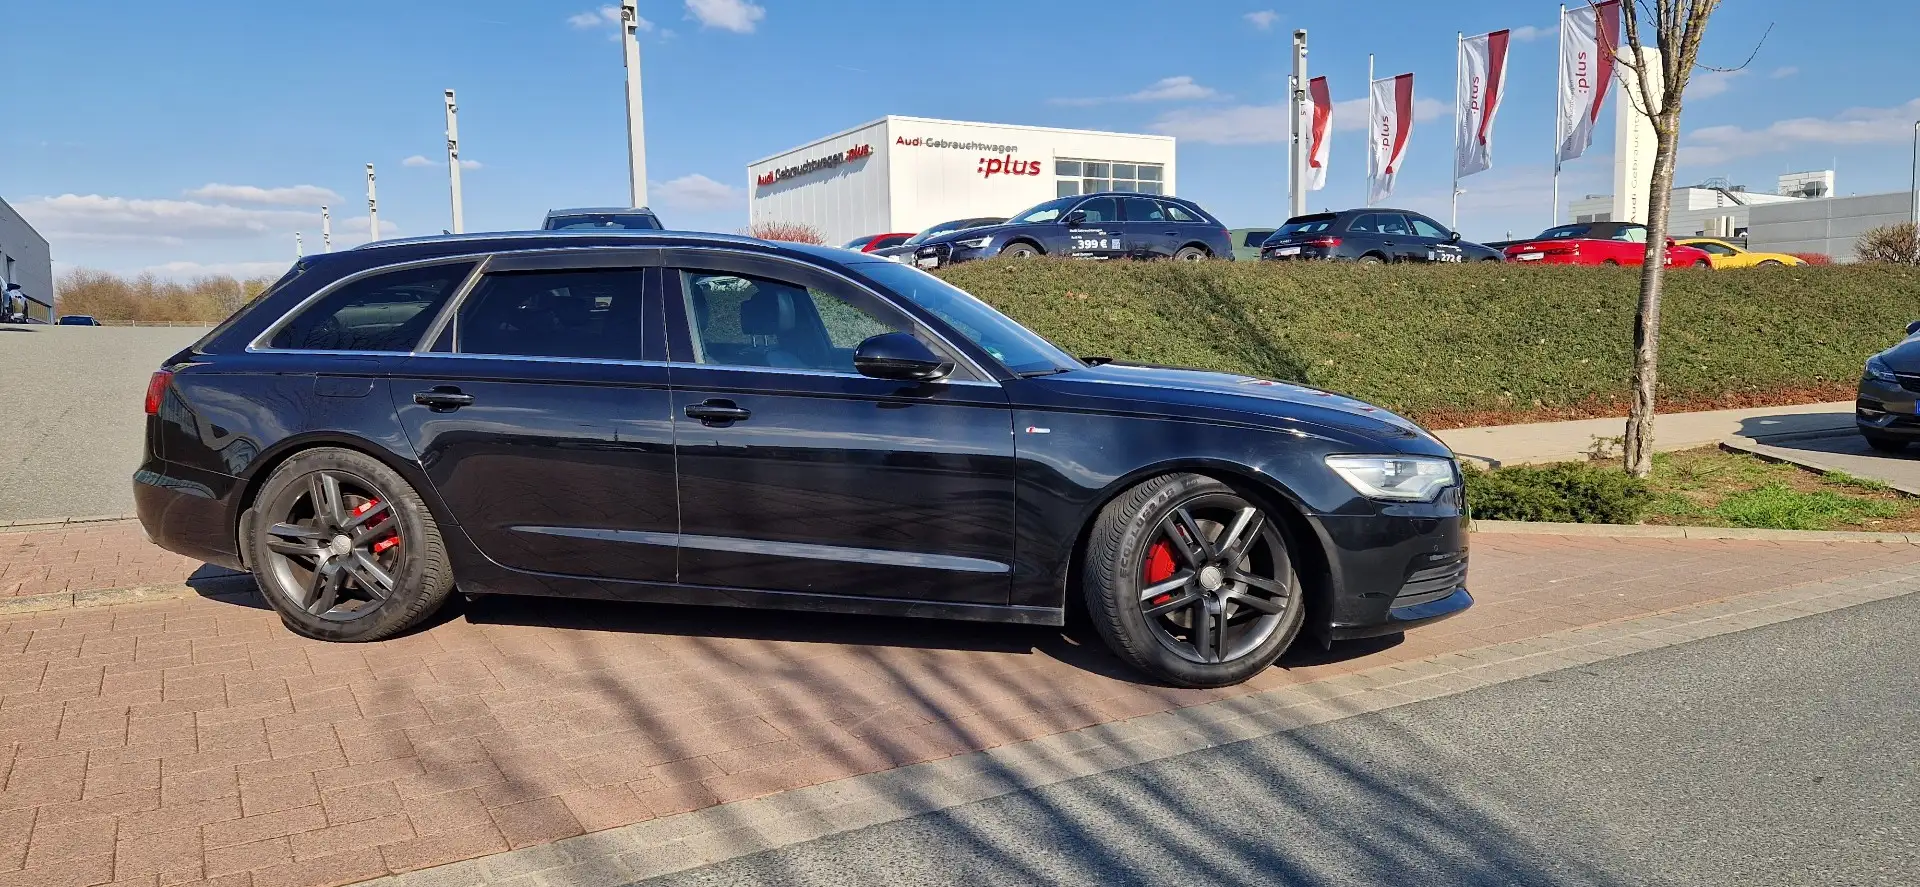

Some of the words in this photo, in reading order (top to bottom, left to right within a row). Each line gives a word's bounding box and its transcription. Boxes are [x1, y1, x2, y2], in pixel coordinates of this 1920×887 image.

[1576, 51, 1590, 94] :plus
[896, 136, 923, 147] Audi
[926, 138, 1018, 154] Gebrauchtwagen
[1381, 115, 1390, 151] :plus
[757, 171, 774, 185] Audi
[775, 152, 844, 180] Gebrauchtwagen
[977, 154, 1041, 179] :plus
[1077, 239, 1098, 249] 399
[1100, 239, 1108, 249] €
[1441, 253, 1456, 263] 272
[1456, 255, 1462, 263] €
